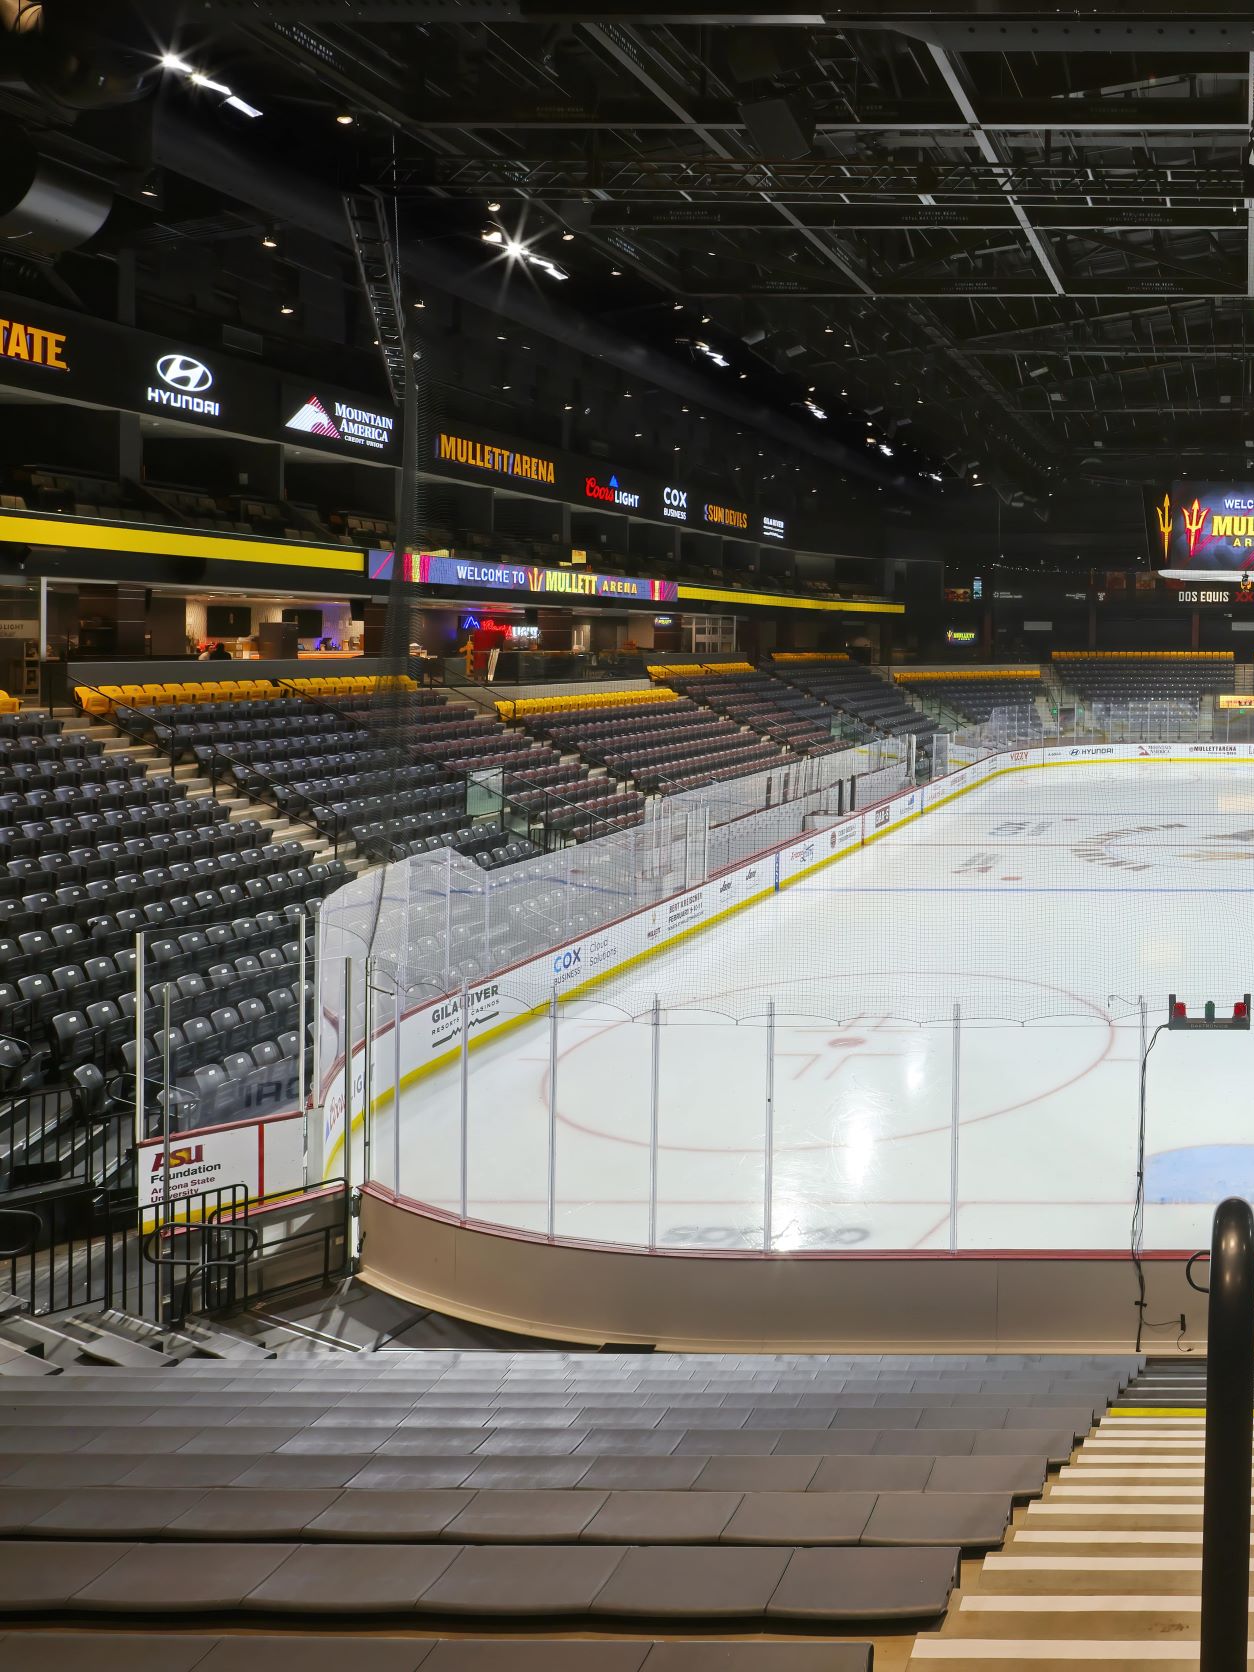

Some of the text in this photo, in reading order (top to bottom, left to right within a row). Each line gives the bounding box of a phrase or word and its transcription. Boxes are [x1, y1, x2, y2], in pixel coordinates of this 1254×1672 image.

[147, 386, 219, 416] HYUNDAI
[334, 402, 393, 430] MOUNTAIN
[339, 417, 389, 443] AMERICA
[344, 435, 365, 446] CREDIT
[439, 433, 555, 484] MULLETT ARENA
[585, 476, 639, 508] Coors LIGHT
[663, 486, 687, 508] COX
[663, 507, 687, 520] BUSINESS
[456, 564, 637, 595] WELCOME TO MULLETT ARENA
[1178, 591, 1198, 602] DOS
[1200, 591, 1230, 602] EQUIS
[553, 947, 581, 973] COX
[553, 968, 582, 985] BUSINESS
[431, 999, 500, 1036] RESORTS CASINOS
[432, 1000, 459, 1024] GILA
[151, 1144, 204, 1172] ASU
[150, 1163, 221, 1184] Foundation
[151, 1176, 216, 1195] Arzona State
[150, 1188, 199, 1203] Unversity
